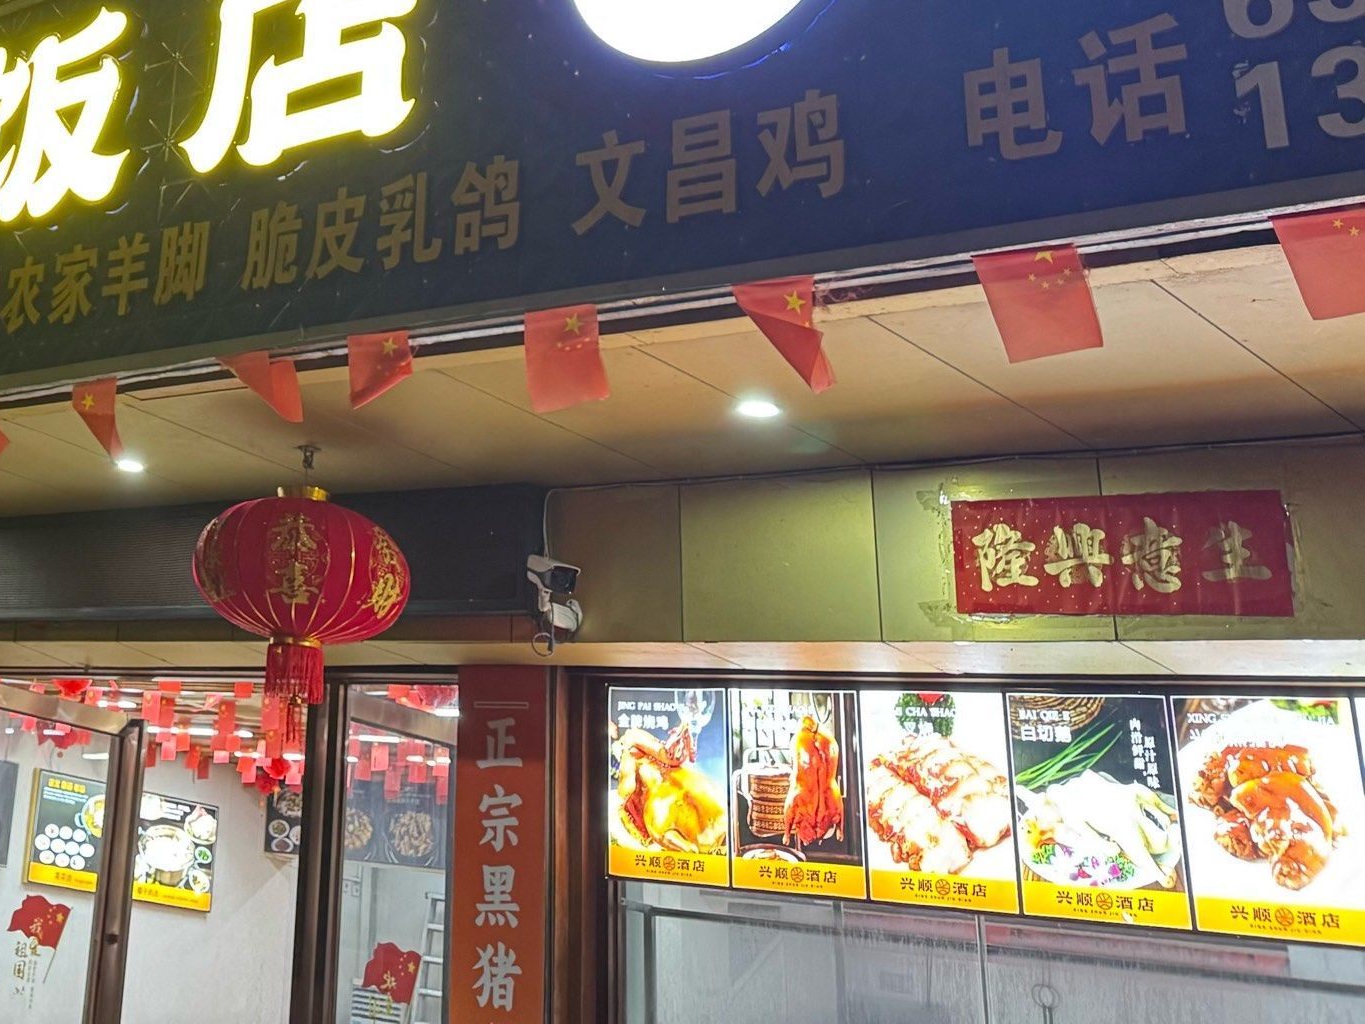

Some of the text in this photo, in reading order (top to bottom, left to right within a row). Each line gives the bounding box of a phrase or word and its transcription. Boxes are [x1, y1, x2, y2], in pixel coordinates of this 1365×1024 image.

[963, 12, 1188, 160] 电话
[1234, 45, 1365, 149] 13
[0, 221, 211, 336] 农家羊脚
[240, 154, 522, 292] 脆皮乳鸽
[571, 88, 846, 237] 文昌鸡
